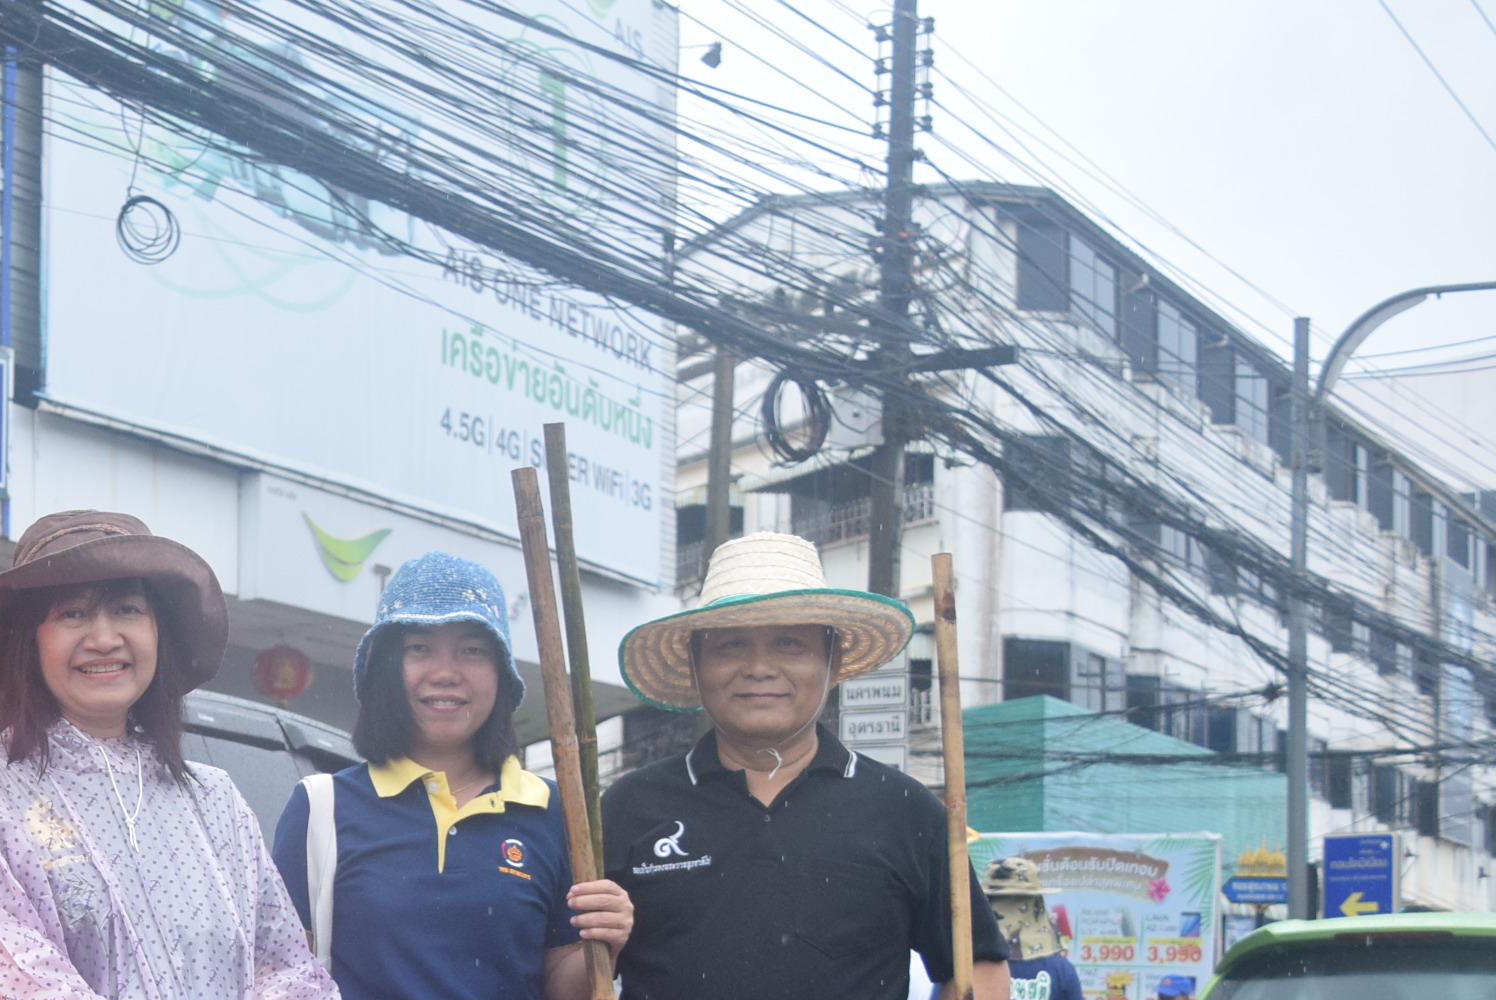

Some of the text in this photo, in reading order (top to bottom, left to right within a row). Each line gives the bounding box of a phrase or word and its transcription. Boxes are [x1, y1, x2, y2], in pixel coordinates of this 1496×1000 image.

[441, 247, 654, 374] AIS ONE NETWORK
[440, 324, 654, 450] เครือข่ายอันดับหนึ่ง
[529, 438, 591, 486] SER
[845, 684, 901, 700] นครพนม
[1080, 944, 1135, 963] 3,990
[1146, 944, 1203, 964] 3,990
